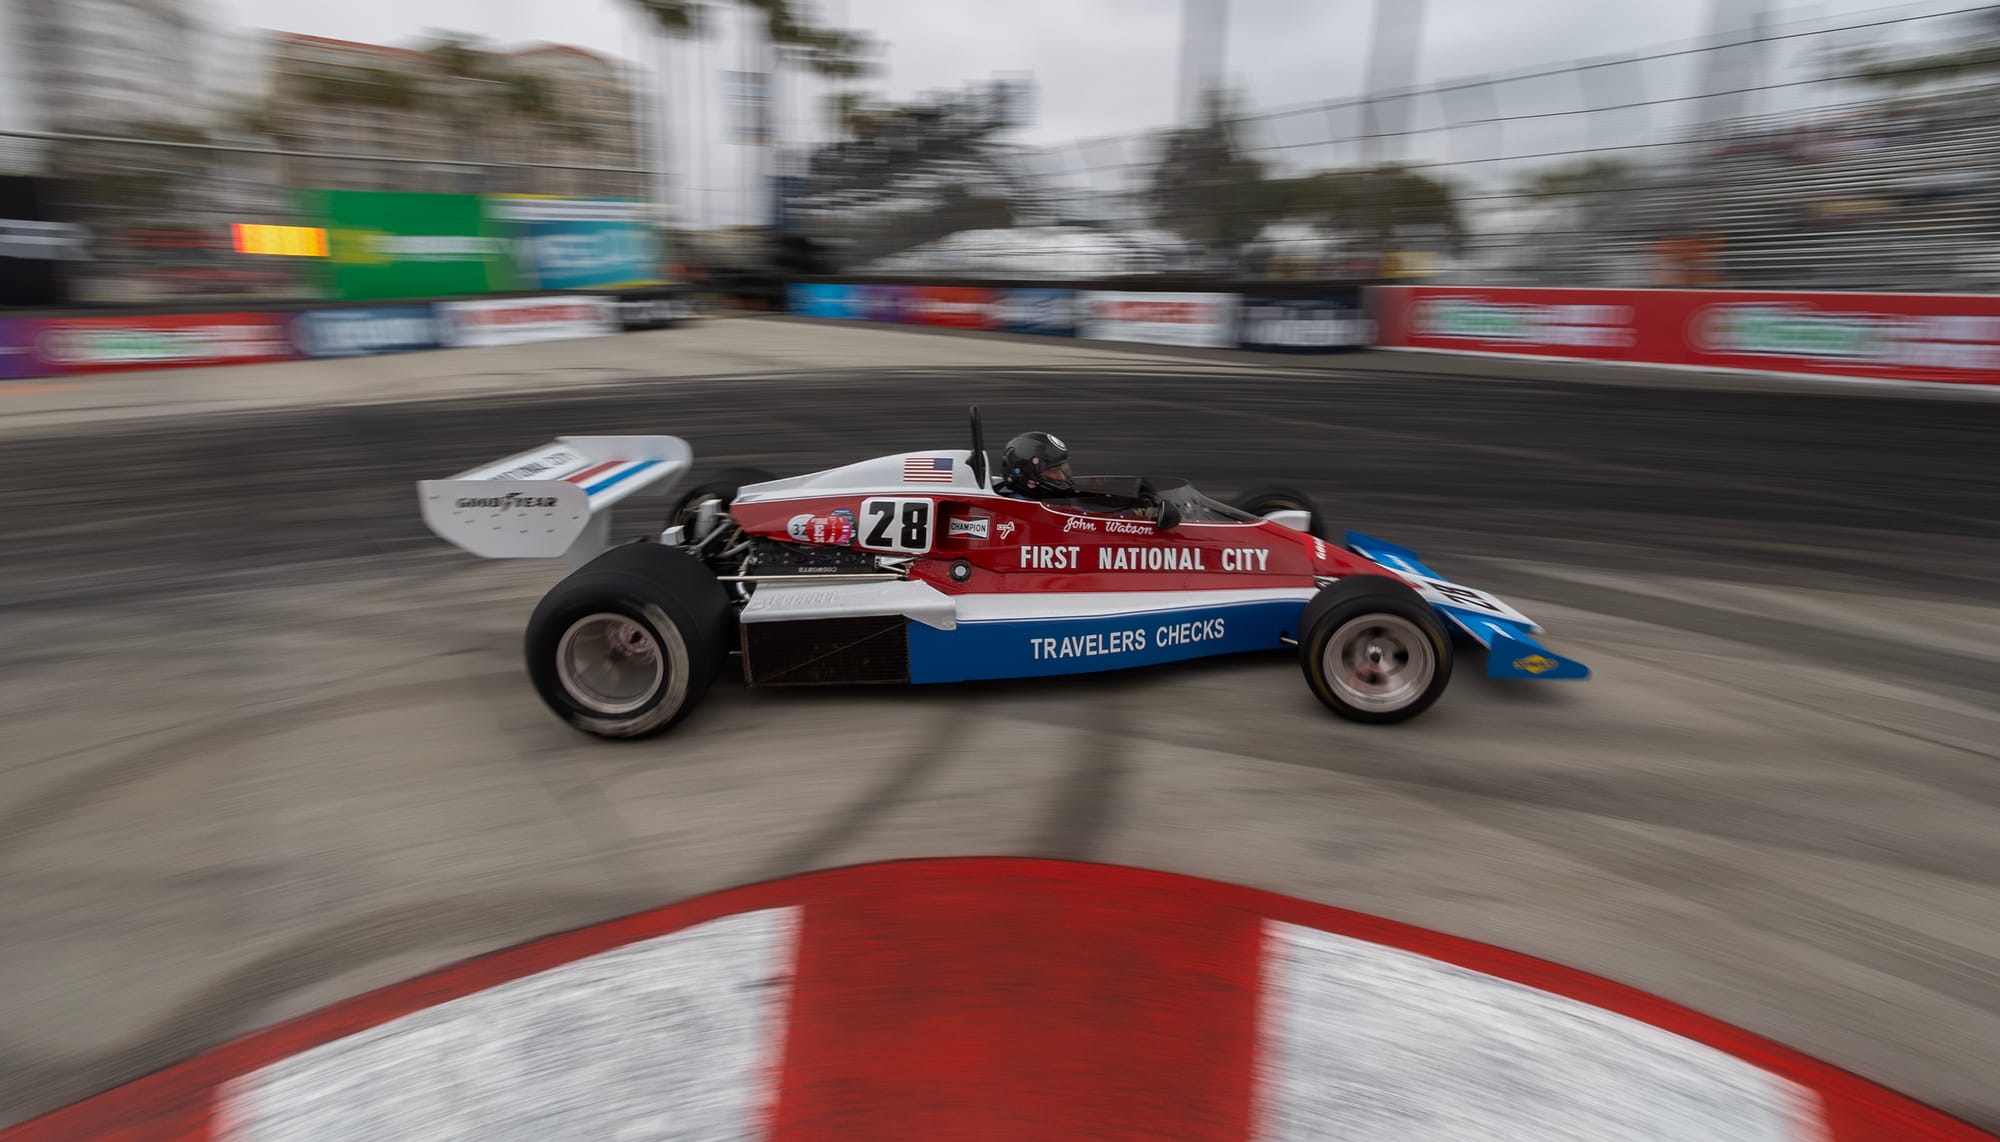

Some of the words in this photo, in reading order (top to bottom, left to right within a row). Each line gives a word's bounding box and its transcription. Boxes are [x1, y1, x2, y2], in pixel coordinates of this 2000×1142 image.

[866, 501, 928, 547] 28
[951, 522, 986, 533] CHAMPION
[1063, 516, 1097, 533] John
[1105, 521, 1154, 535] Watson
[1020, 545, 1080, 569] FIRST
[1099, 547, 1205, 570] NATIONAL
[1221, 548, 1269, 571] CITY
[1031, 629, 1146, 659] TRAVELERS
[1156, 618, 1225, 648] CHECKS
